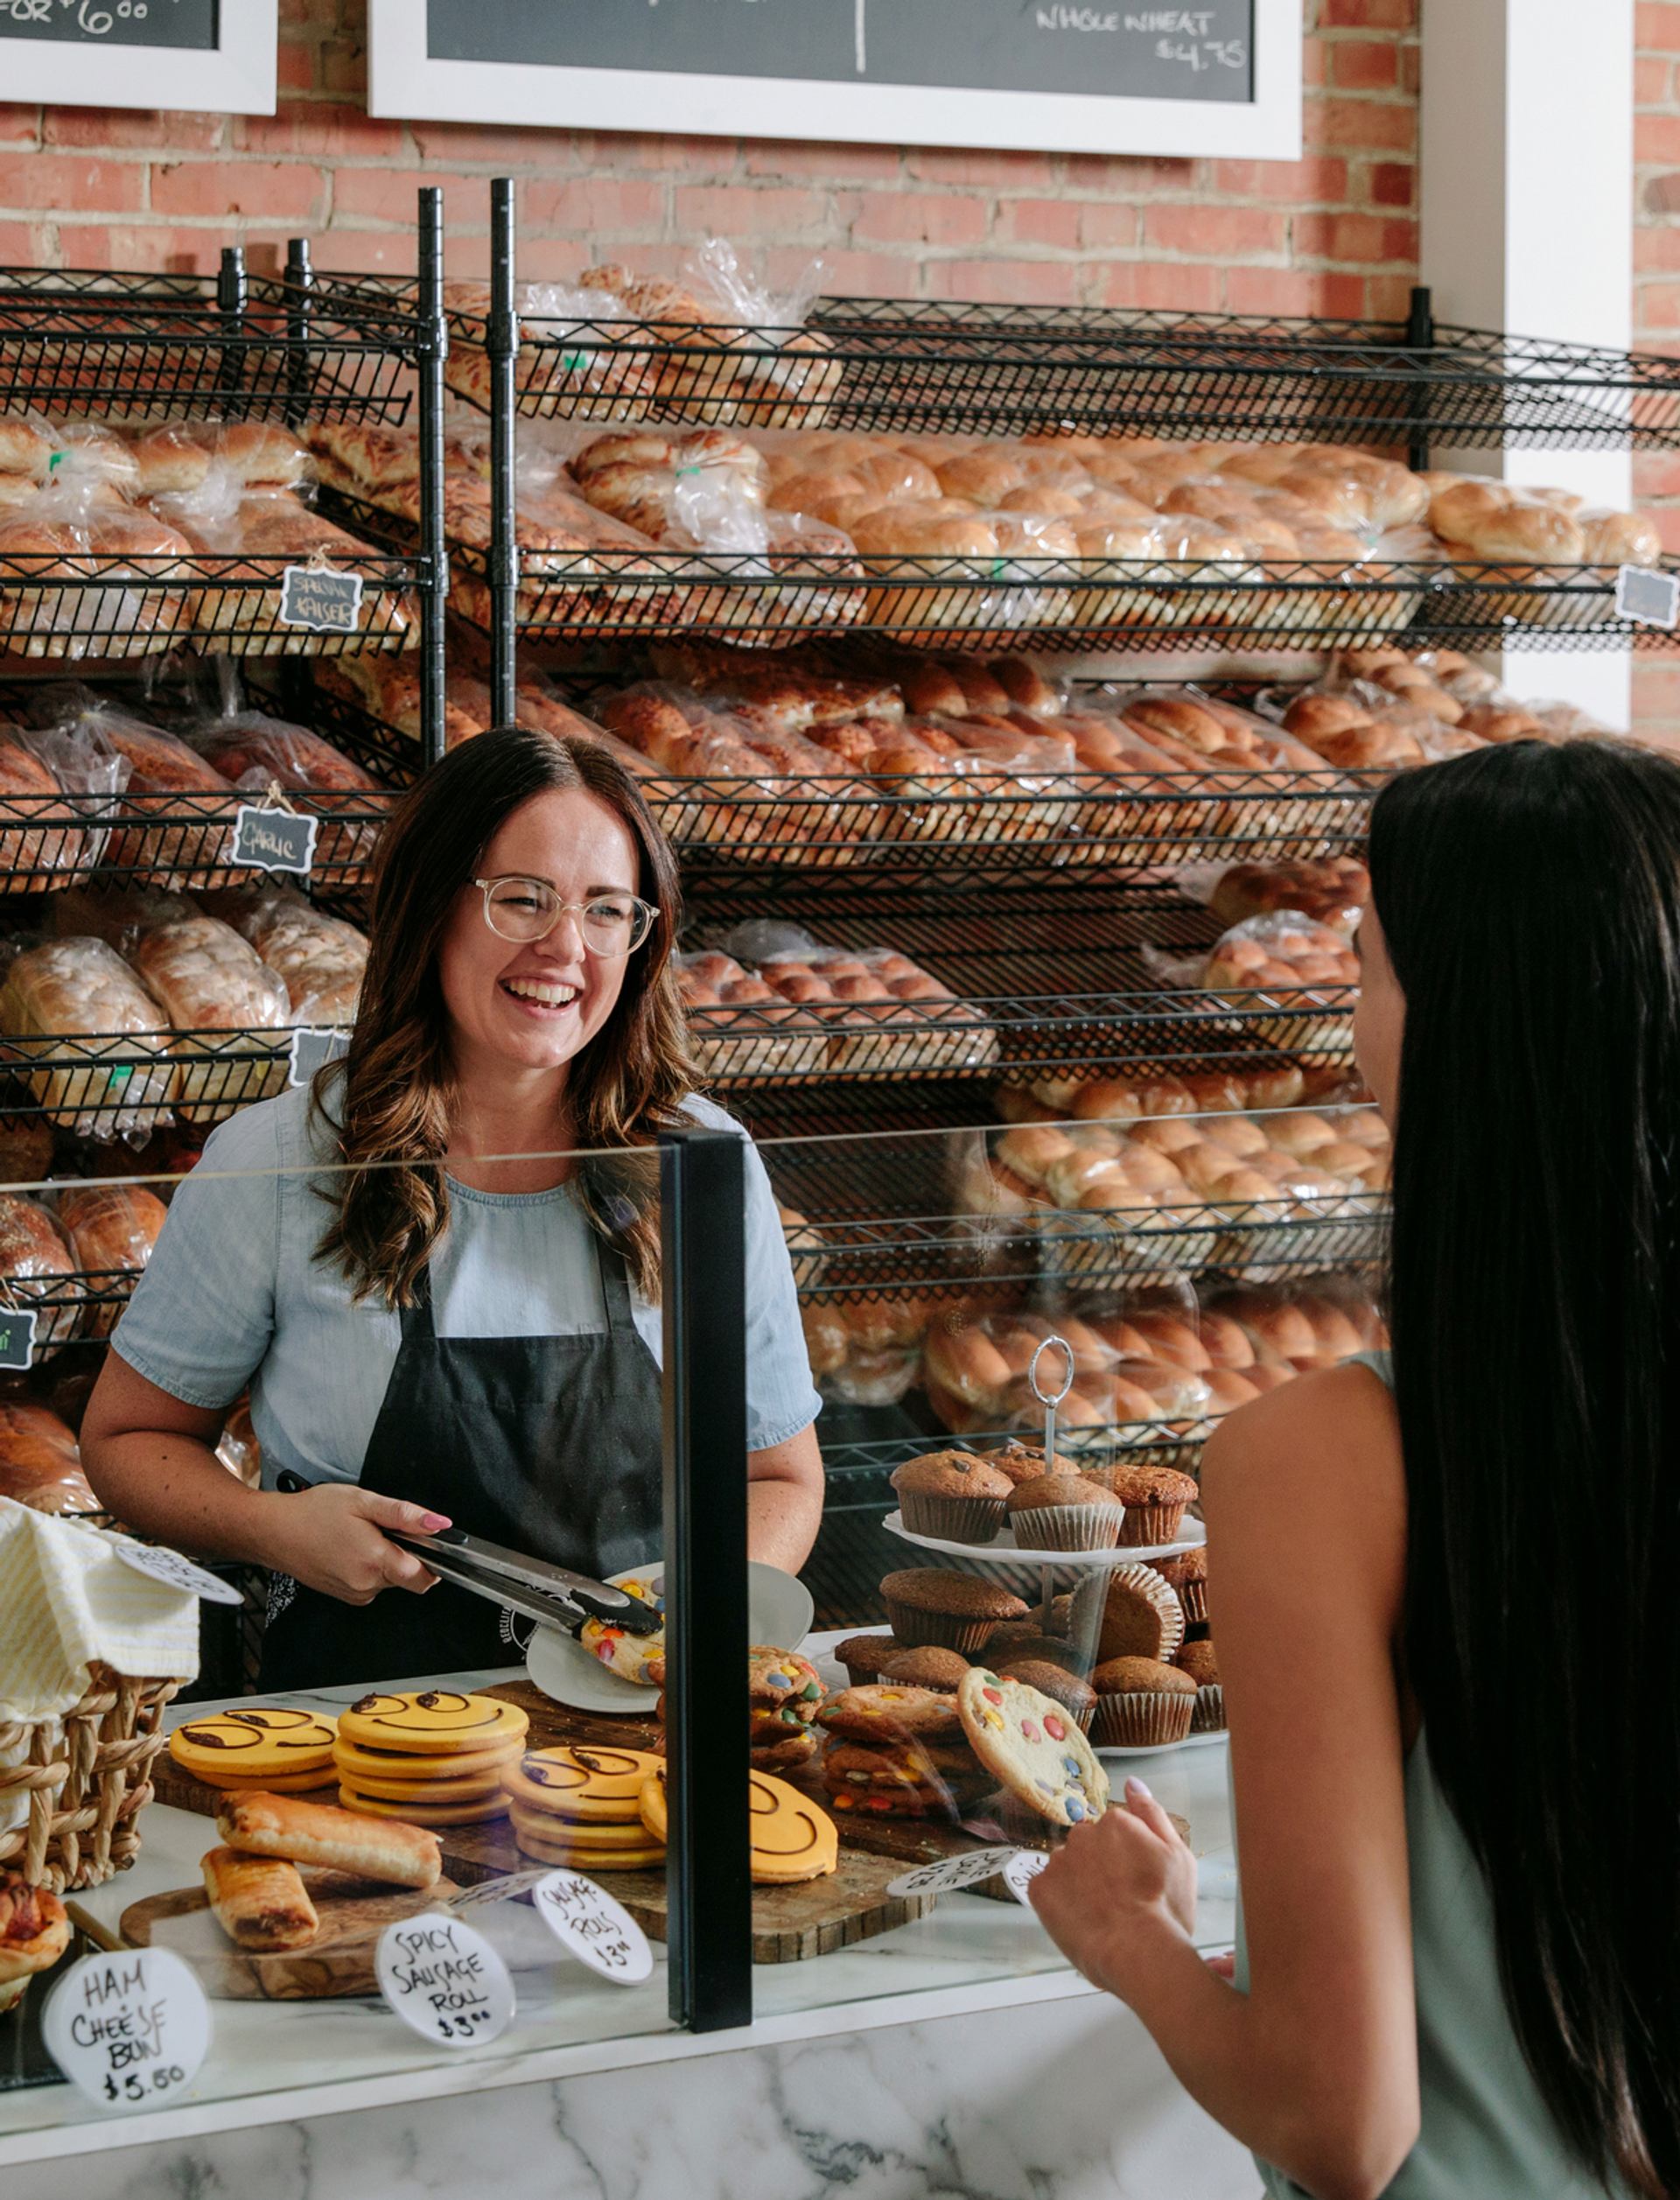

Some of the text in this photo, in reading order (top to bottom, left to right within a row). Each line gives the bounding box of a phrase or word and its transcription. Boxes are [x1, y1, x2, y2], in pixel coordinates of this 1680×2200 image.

[0, 0, 52, 23] OR
[1035, 4, 1217, 37] WHOLE WHEAT
[1155, 39, 1247, 72] $4.75
[295, 597, 352, 624] KAISER
[242, 822, 298, 860] GARLIC
[570, 1910, 622, 1941] ROLLS
[395, 1924, 458, 1965] SPICY
[83, 1958, 146, 2007] HAM
[391, 1952, 485, 1994] SAUSAGE
[428, 1988, 488, 2013] ROLL
[71, 1997, 167, 2048] CHEESE
[108, 2040, 163, 2070] BUN
[104, 2064, 186, 2102] $5.50
